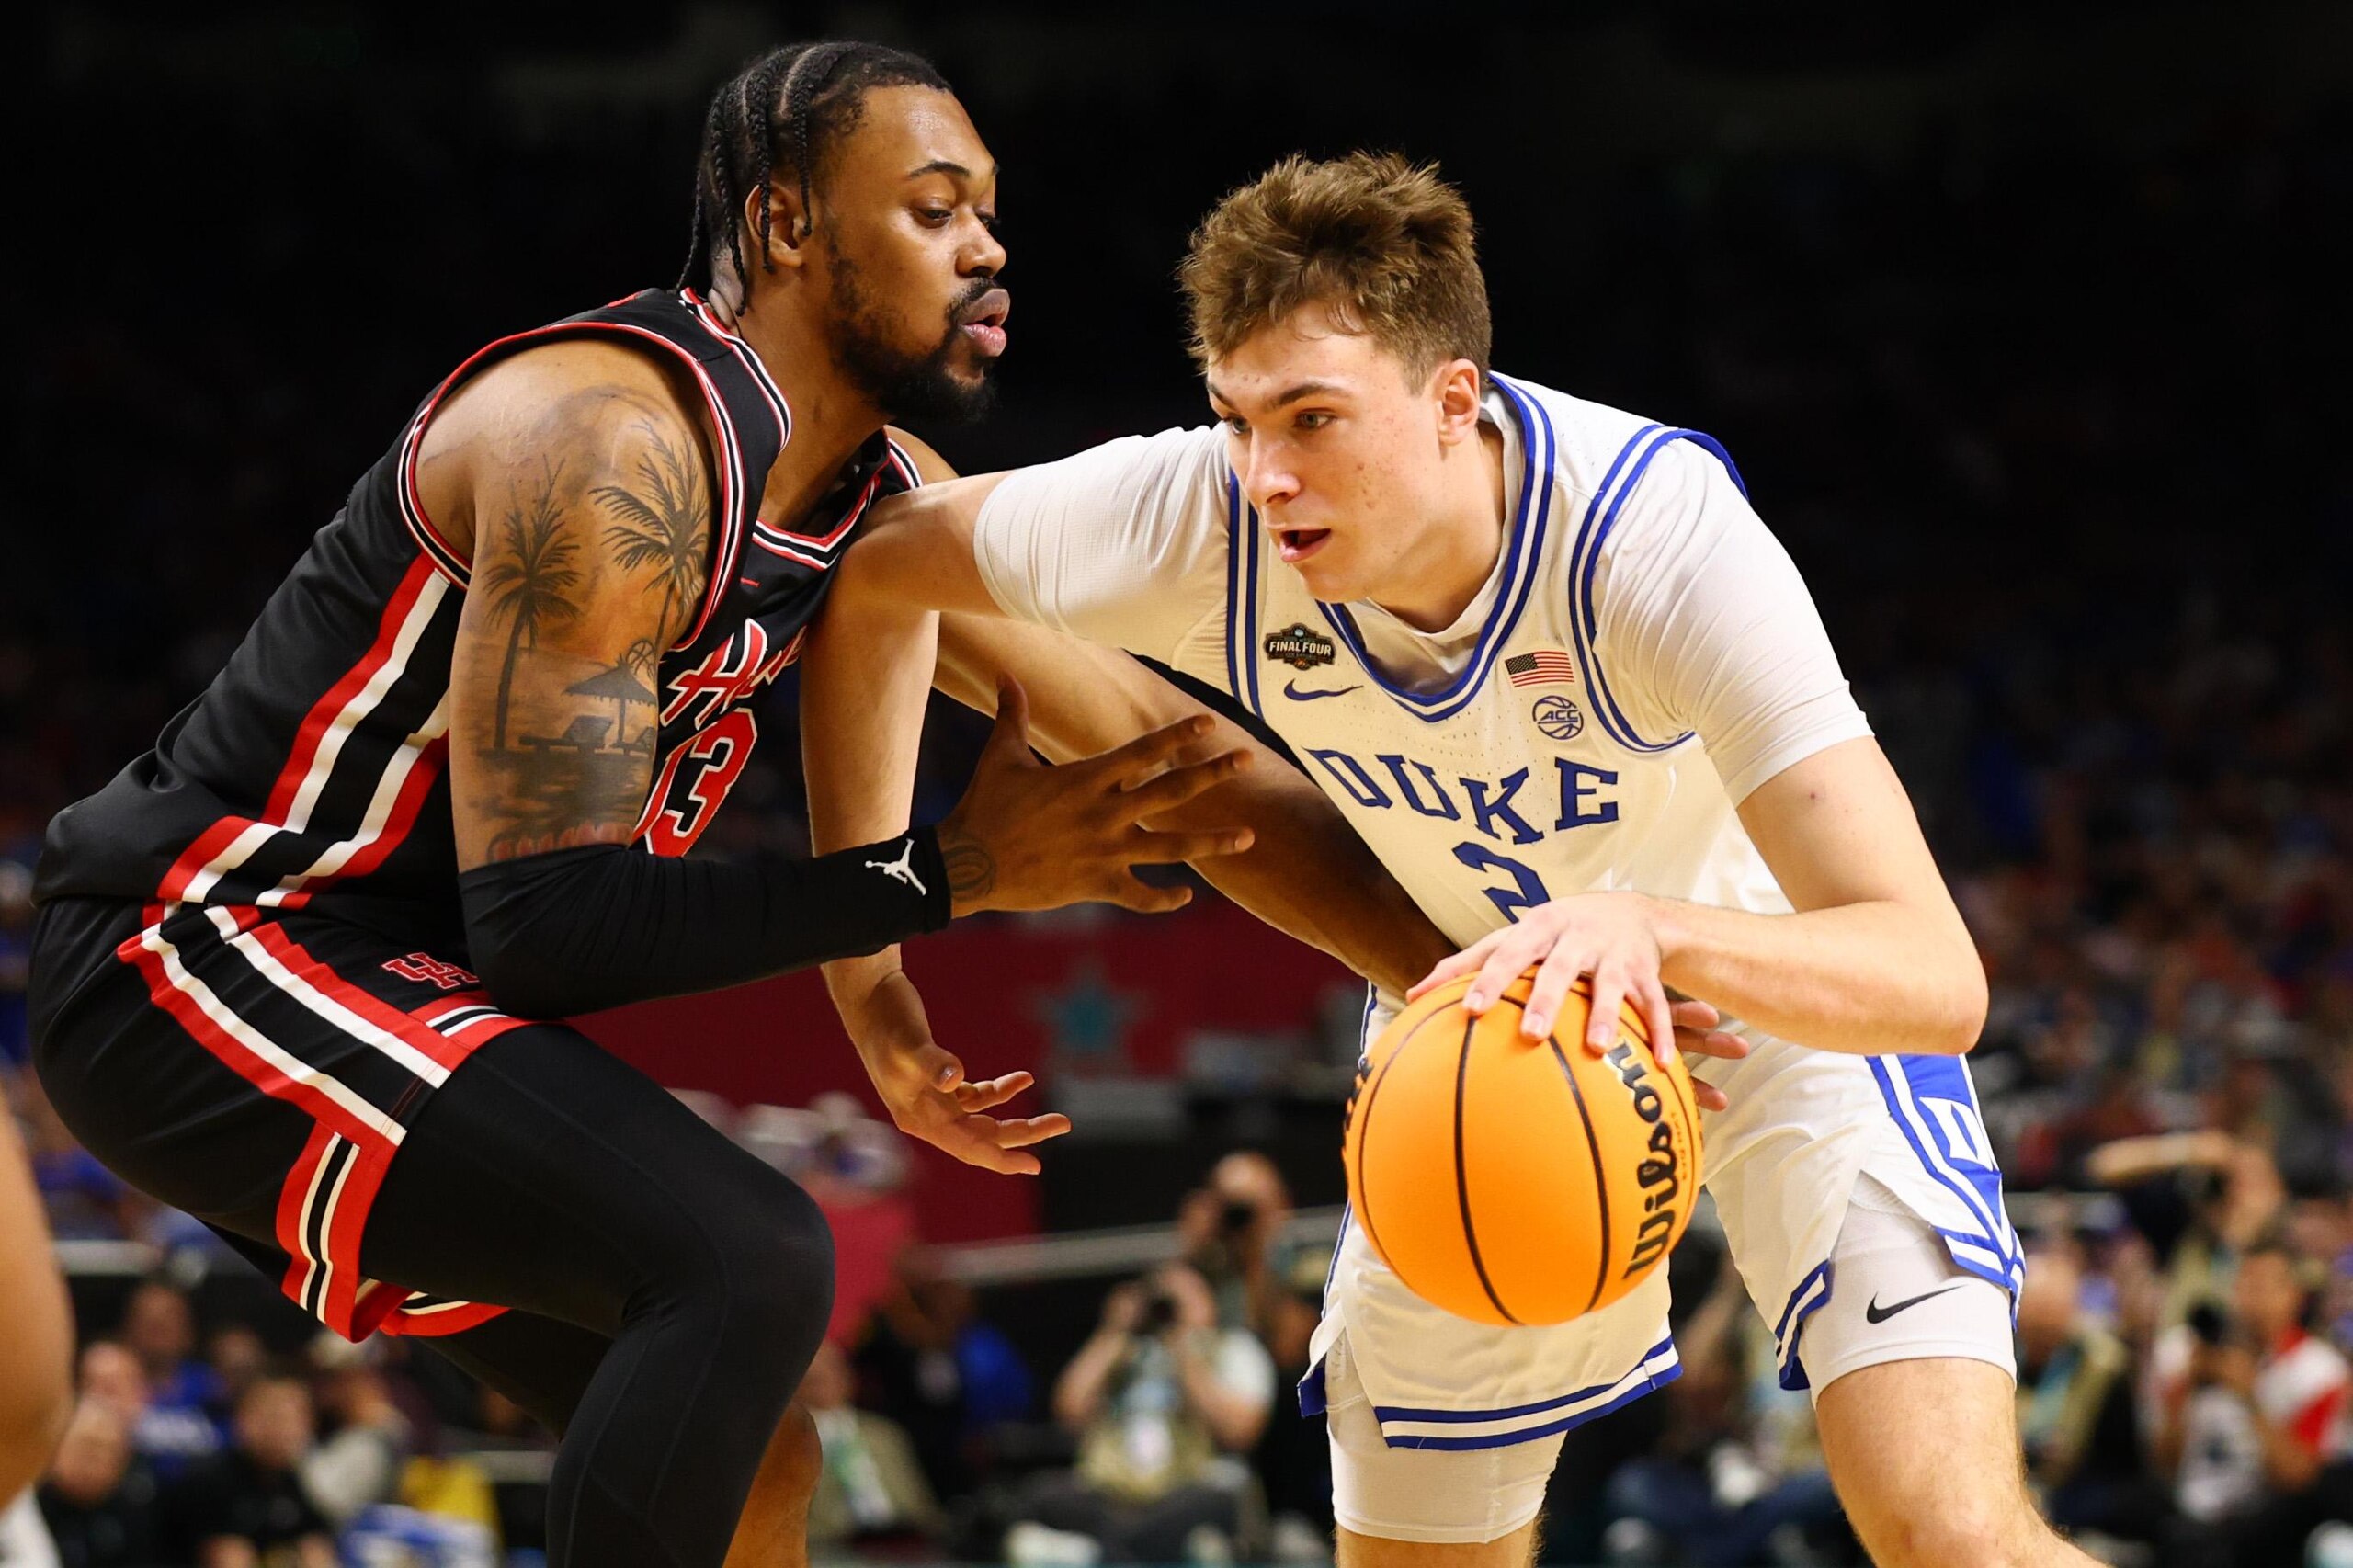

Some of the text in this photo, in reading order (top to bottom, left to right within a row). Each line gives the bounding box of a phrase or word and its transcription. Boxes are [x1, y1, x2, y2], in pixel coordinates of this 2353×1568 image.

[1269, 641, 1301, 653] FINAL
[1302, 642, 1332, 656] FOUR
[1539, 710, 1579, 723] ACC
[1302, 746, 1619, 845] DUKE
[1452, 841, 1551, 924] 2
[1606, 1038, 1678, 1279] Wilson
